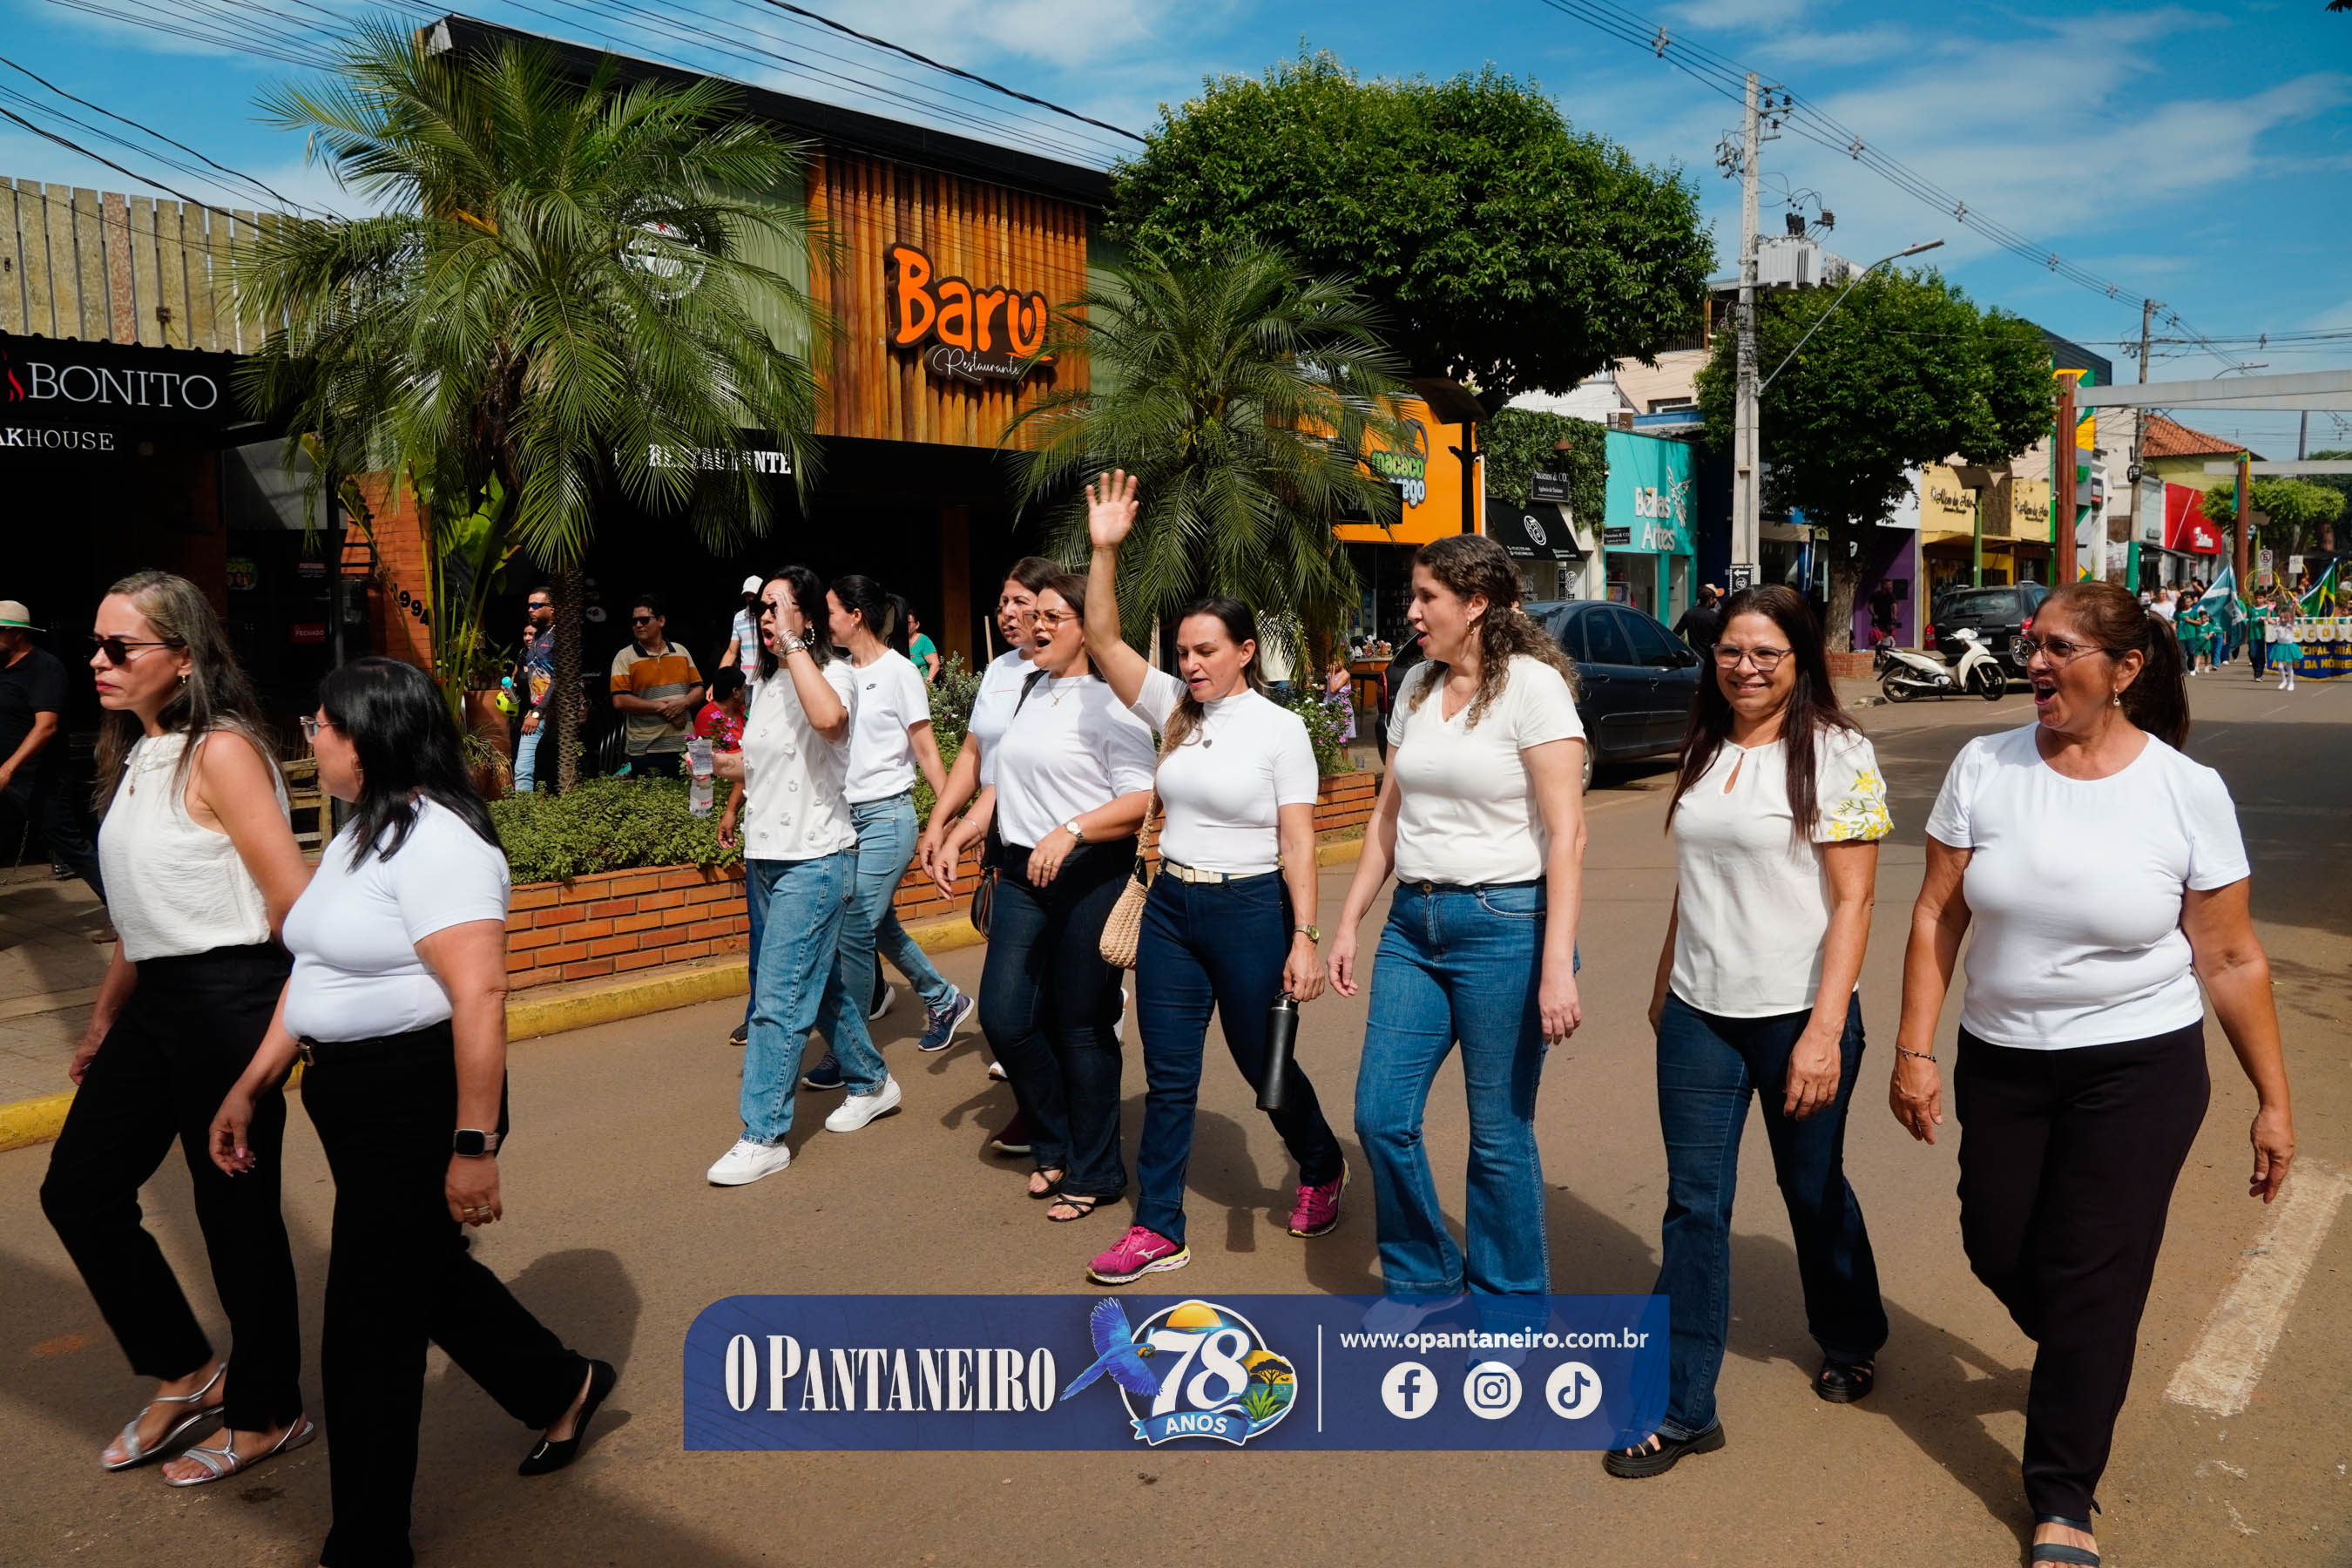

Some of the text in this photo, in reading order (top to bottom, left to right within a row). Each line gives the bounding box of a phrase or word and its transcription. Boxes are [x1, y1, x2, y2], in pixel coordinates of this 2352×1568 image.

[932, 348, 1021, 382] Restaurante
[26, 362, 218, 410] BONITO
[1635, 487, 1671, 518] Bellas
[1641, 521, 1675, 551] Artes
